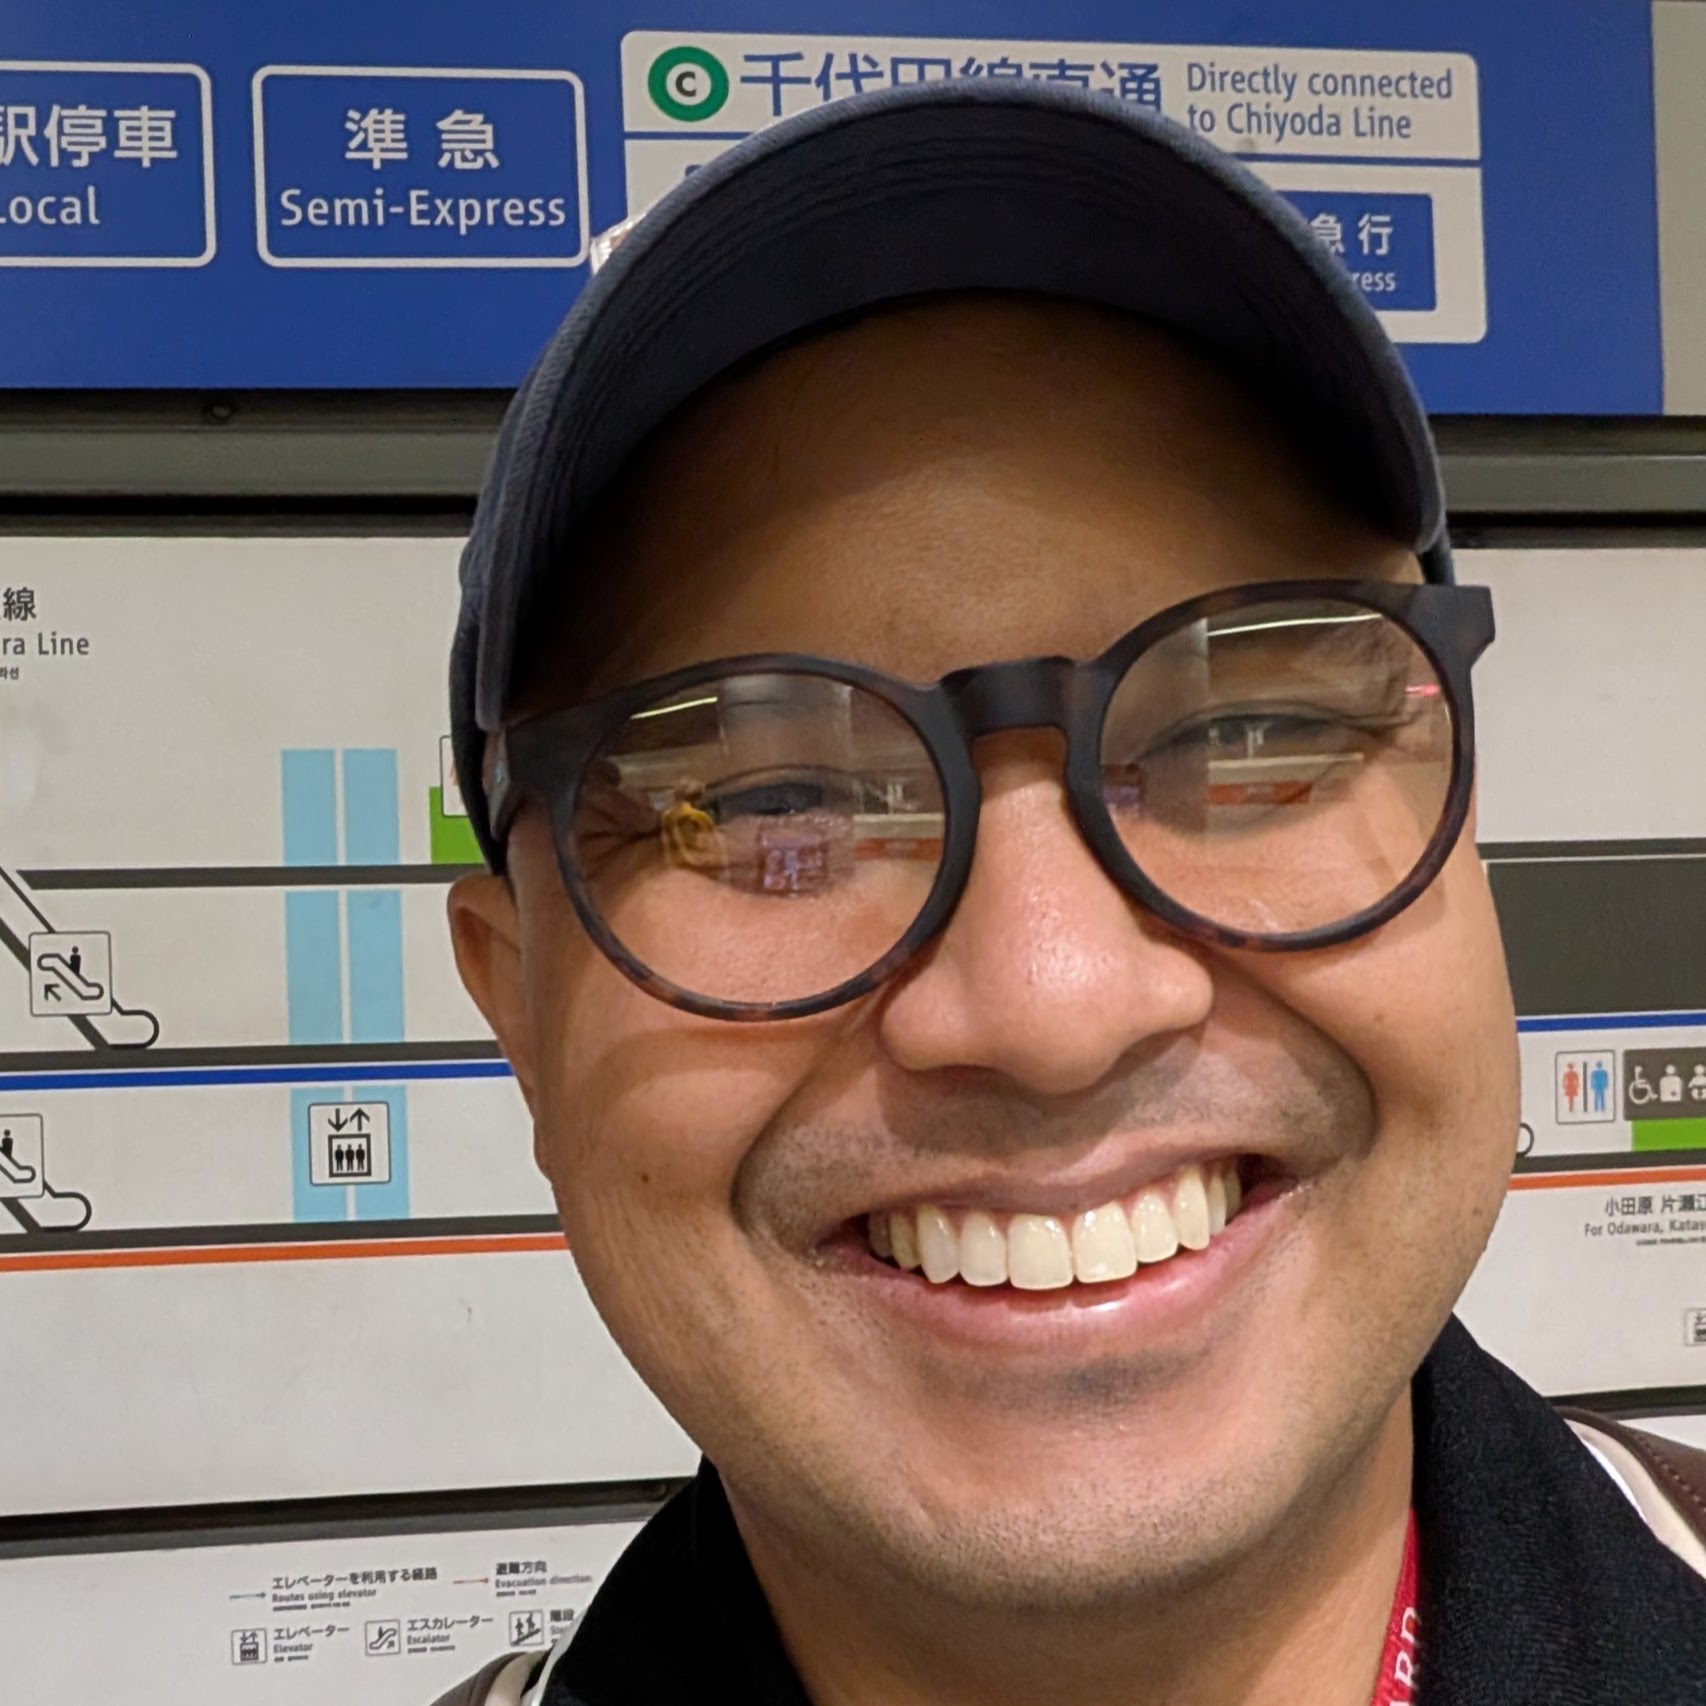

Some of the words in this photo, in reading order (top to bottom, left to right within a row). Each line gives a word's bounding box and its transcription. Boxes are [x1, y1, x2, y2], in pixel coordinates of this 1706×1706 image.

[675, 70, 697, 97] C
[1187, 62, 1297, 101] Directly
[1307, 69, 1453, 99] connected
[1188, 104, 1215, 133] to
[1226, 103, 1341, 143] Chiyoda
[1353, 106, 1412, 139] Line
[280, 187, 566, 235] Semi-Express
[0, 586, 37, 621] 線
[2, 637, 26, 655] ra
[38, 631, 90, 655] Line
[1585, 1222, 1603, 1236] For
[273, 1625, 349, 1641] エレベーター
[407, 1615, 494, 1631] エスカレーター
